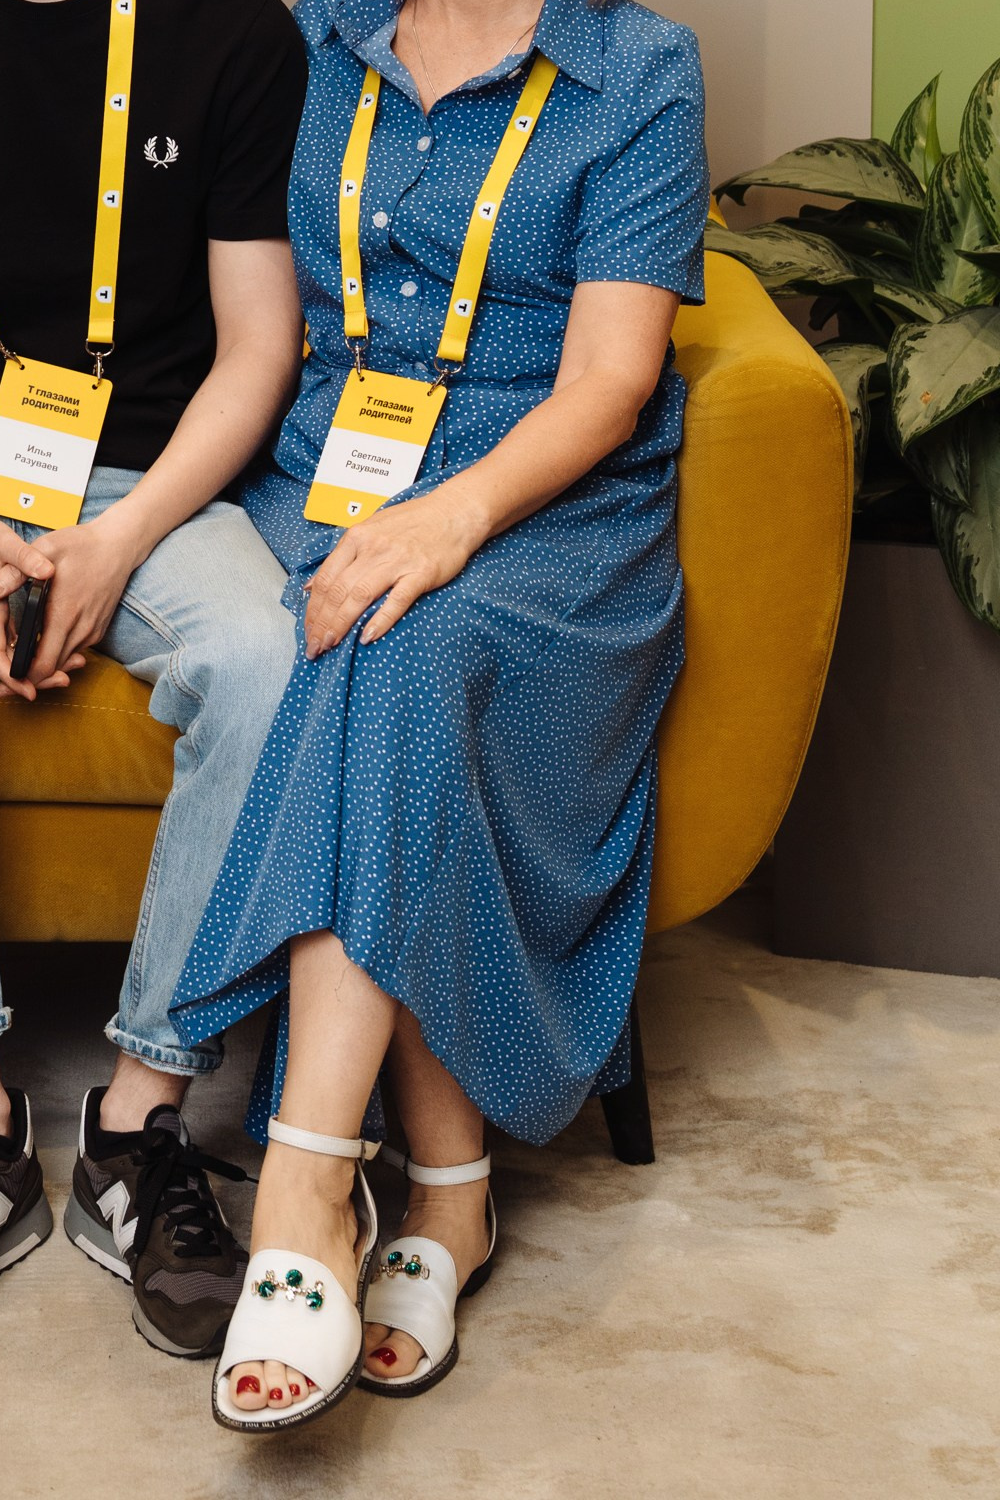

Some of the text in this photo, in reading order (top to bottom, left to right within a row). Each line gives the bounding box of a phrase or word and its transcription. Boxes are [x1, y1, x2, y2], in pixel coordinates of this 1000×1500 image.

[28, 385, 80, 407] Т глазами
[366, 395, 414, 414] Т глазами
[21, 396, 80, 418] родителей
[359, 407, 413, 425] родителей
[27, 444, 53, 458] Илья
[351, 449, 392, 465] Светлана
[14, 453, 59, 472] Разуваев
[345, 460, 390, 477] Разуваева
